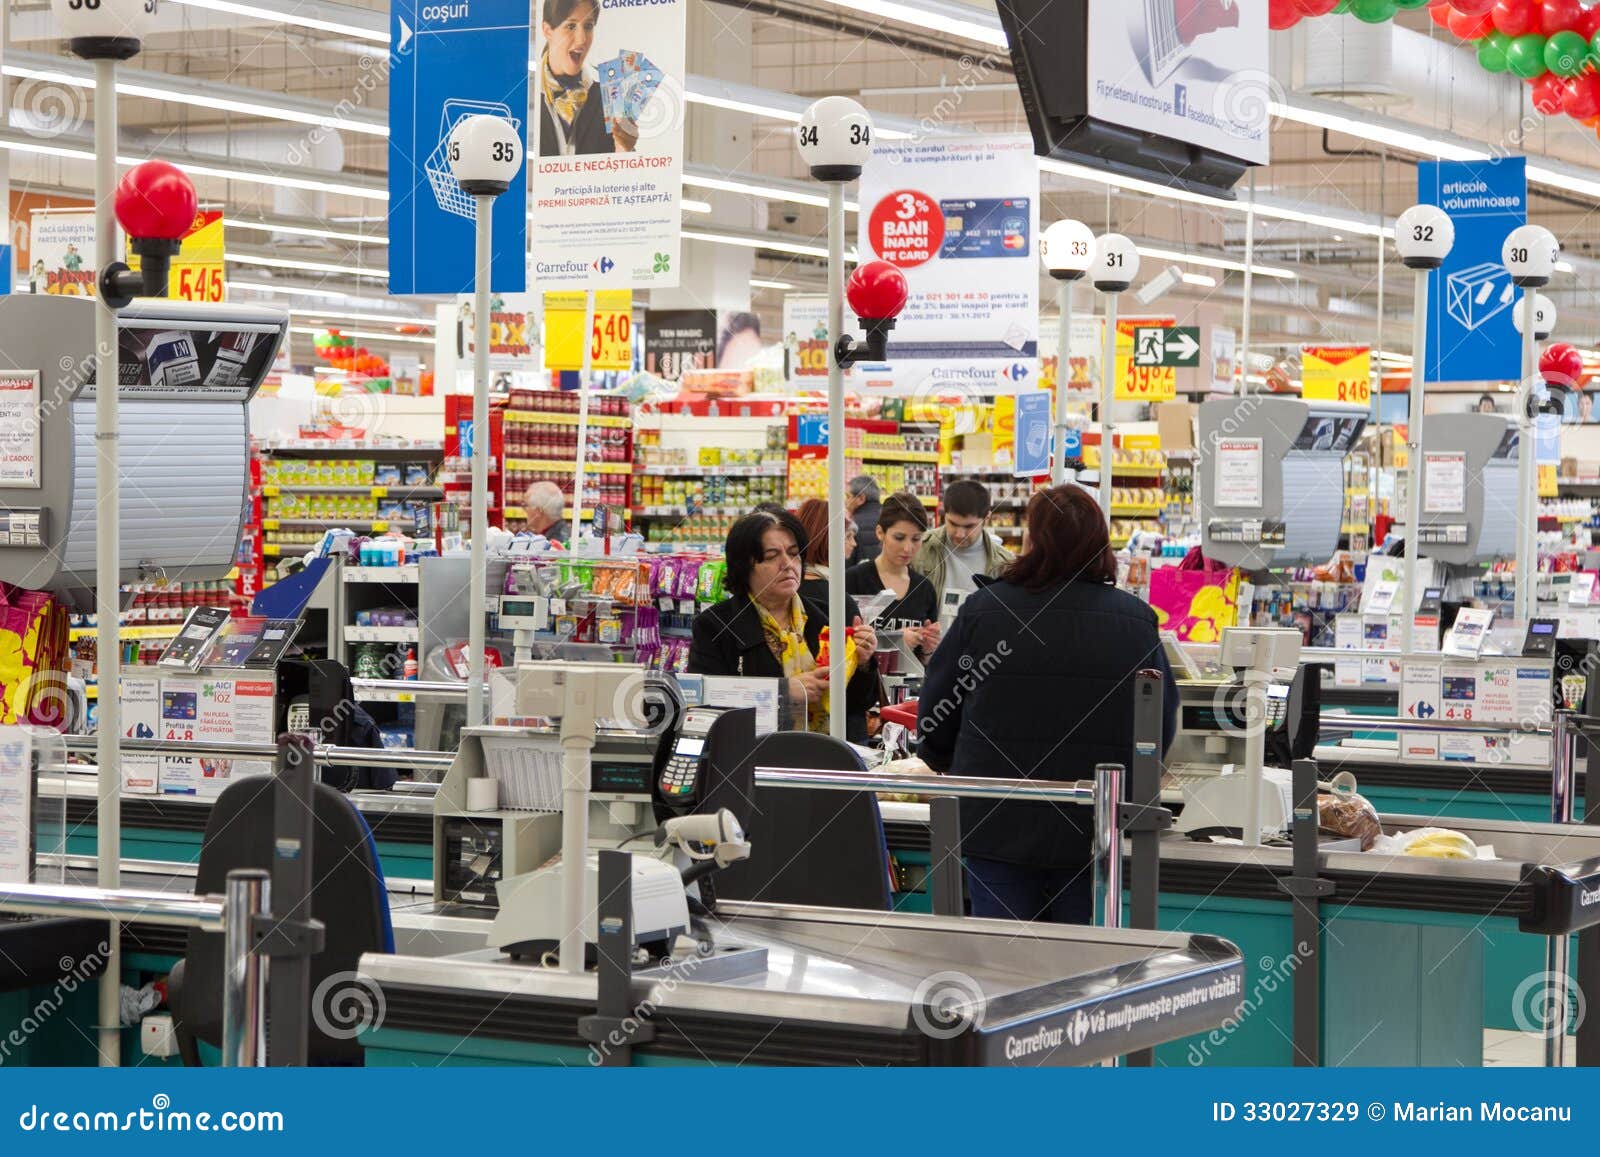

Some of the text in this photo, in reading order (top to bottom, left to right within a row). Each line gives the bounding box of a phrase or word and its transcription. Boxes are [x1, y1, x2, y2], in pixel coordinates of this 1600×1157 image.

[800, 126, 819, 146] 34
[850, 124, 870, 146] 34
[493, 141, 514, 162] 35
[903, 155, 912, 163] la
[986, 152, 995, 161] ai
[539, 161, 573, 173] LOZUL
[575, 162, 581, 172] E
[555, 184, 593, 197] Participă
[593, 185, 601, 194] la
[602, 183, 630, 194] loterie
[640, 182, 656, 192] alte
[1443, 181, 1487, 195] articole
[538, 199, 566, 208] PREMII
[568, 195, 610, 207] SURPRIZĂ
[612, 196, 623, 205] TE
[1443, 195, 1520, 211] voluminoase
[883, 220, 929, 236] BANI
[1413, 225, 1433, 242] 32
[883, 234, 929, 249] ÎNAPOI
[1071, 240, 1088, 256] 33
[883, 249, 929, 261] PE CARD
[1107, 252, 1123, 268] 31
[1511, 248, 1528, 263] 30
[536, 260, 589, 274] Carrefour
[660, 329, 703, 338] TEN MAGIC
[932, 367, 997, 379] Carrefour
[0, 410, 12, 418] ENT
[1365, 658, 1385, 666] FIXE
[215, 682, 232, 690] AICI
[165, 721, 194, 730] Profită de
[215, 718, 232, 726] LOZUL
[1005, 1025, 1064, 1060] Carrefour
[1090, 1013, 1106, 1035] Vă
[1106, 996, 1172, 1032] mulțumește
[1172, 986, 1208, 1016] pentru
